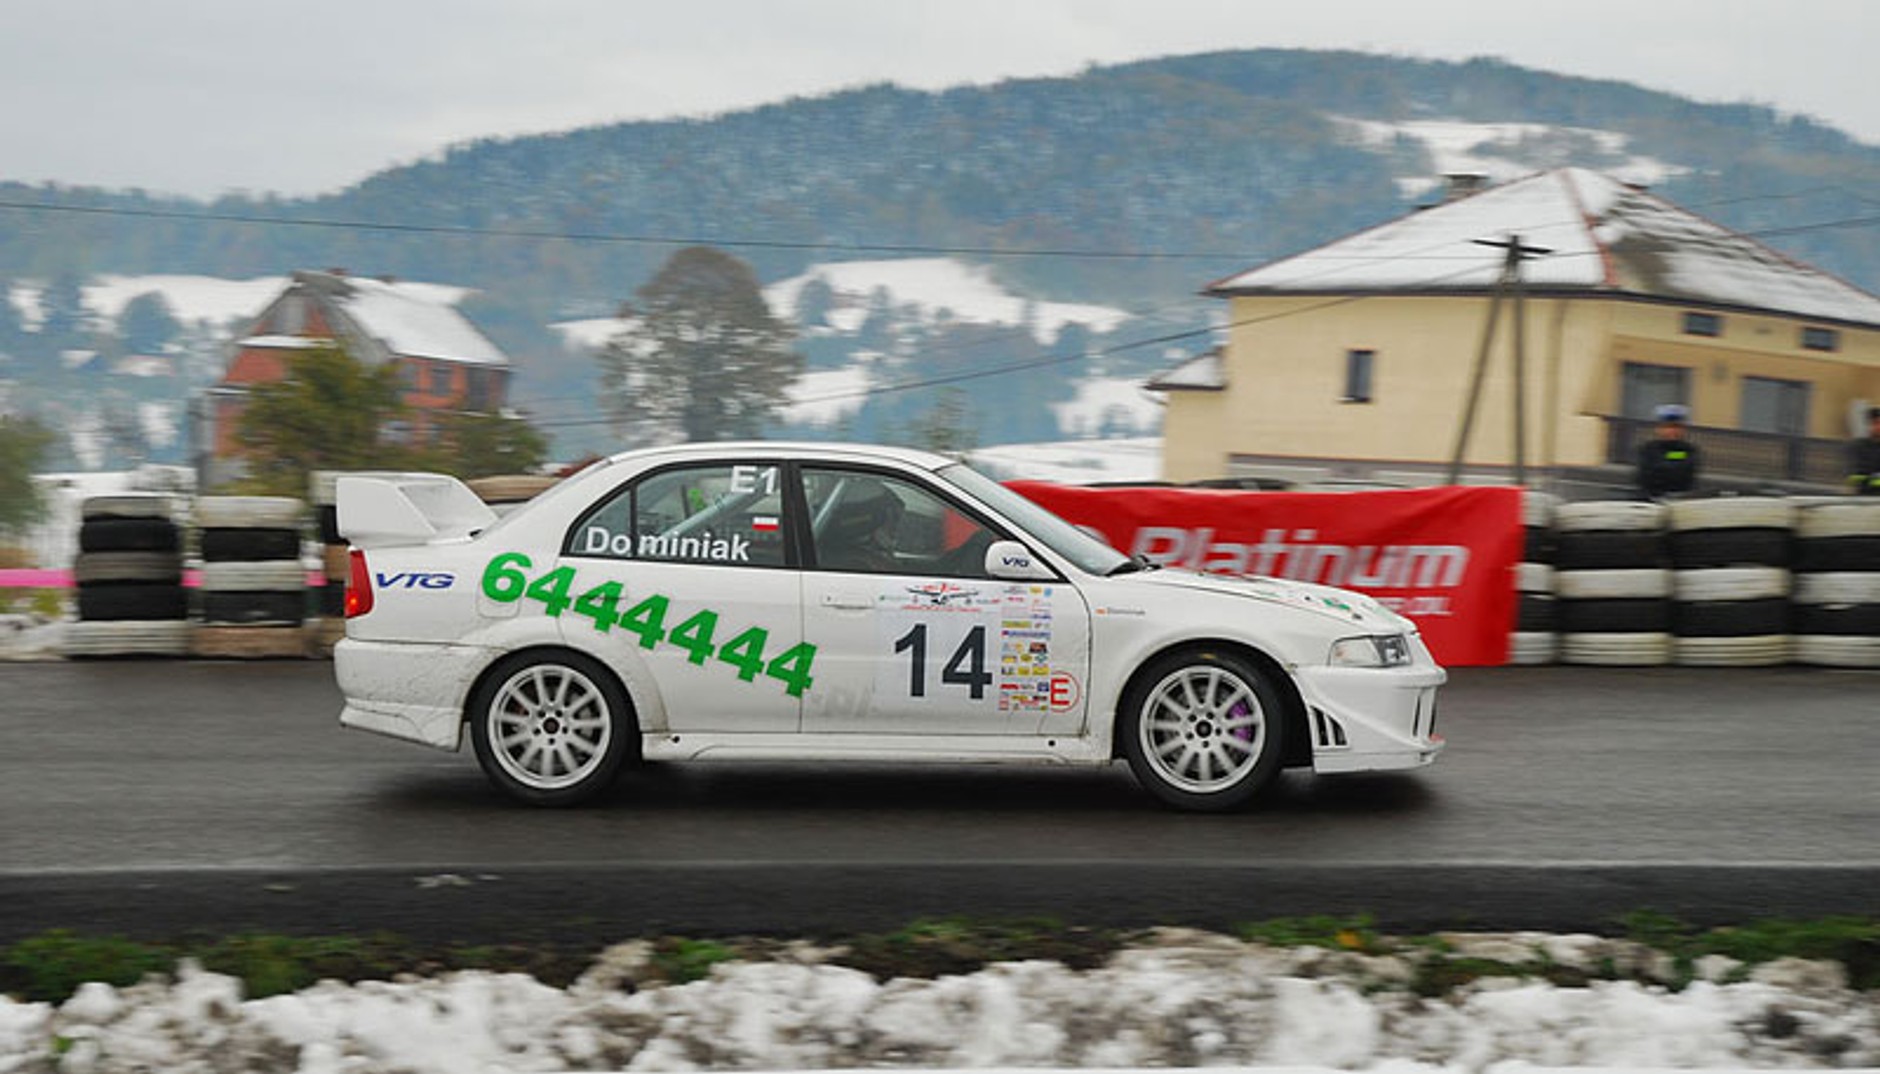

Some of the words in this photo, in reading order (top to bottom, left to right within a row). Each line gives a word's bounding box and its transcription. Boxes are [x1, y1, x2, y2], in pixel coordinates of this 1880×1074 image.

[730, 465, 779, 494] E1
[1130, 526, 1470, 588] Platinum
[375, 573, 455, 590] VTG
[481, 552, 818, 698] 6444444
[895, 623, 992, 699] 14
[1050, 678, 1070, 705] E
